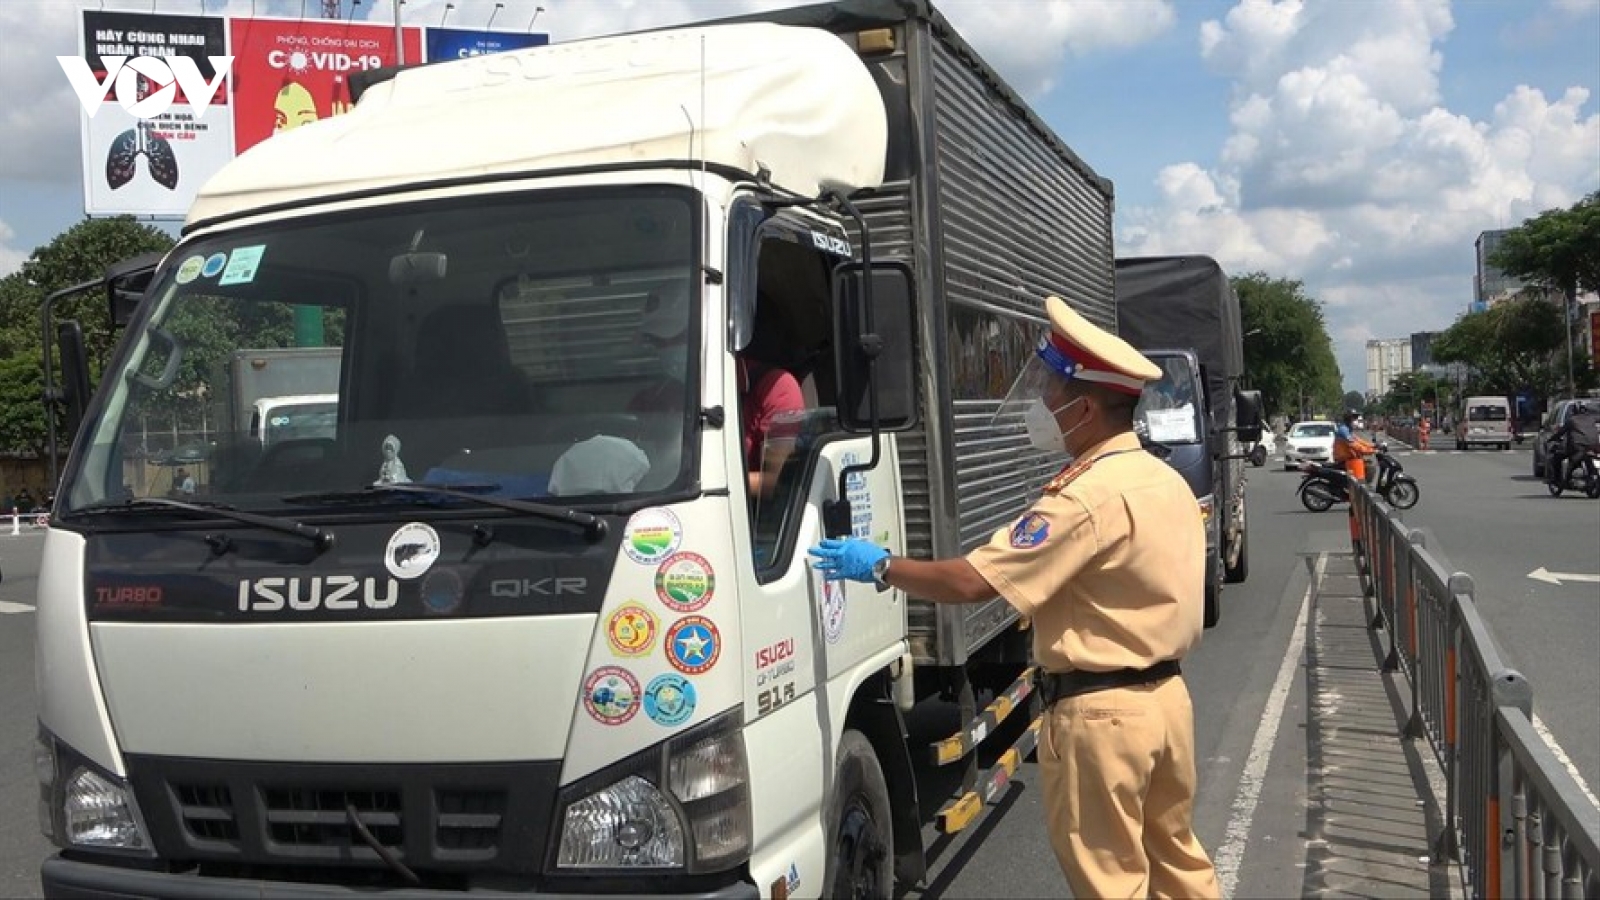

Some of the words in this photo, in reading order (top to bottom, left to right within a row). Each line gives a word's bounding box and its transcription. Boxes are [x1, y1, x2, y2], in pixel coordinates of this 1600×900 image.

[127, 30, 166, 44] CÙNG
[169, 33, 205, 46] NHAU
[95, 586, 162, 602] TURBO
[237, 576, 398, 611] ISUZU
[490, 577, 588, 598] QKR
[755, 637, 794, 670] ISUZU
